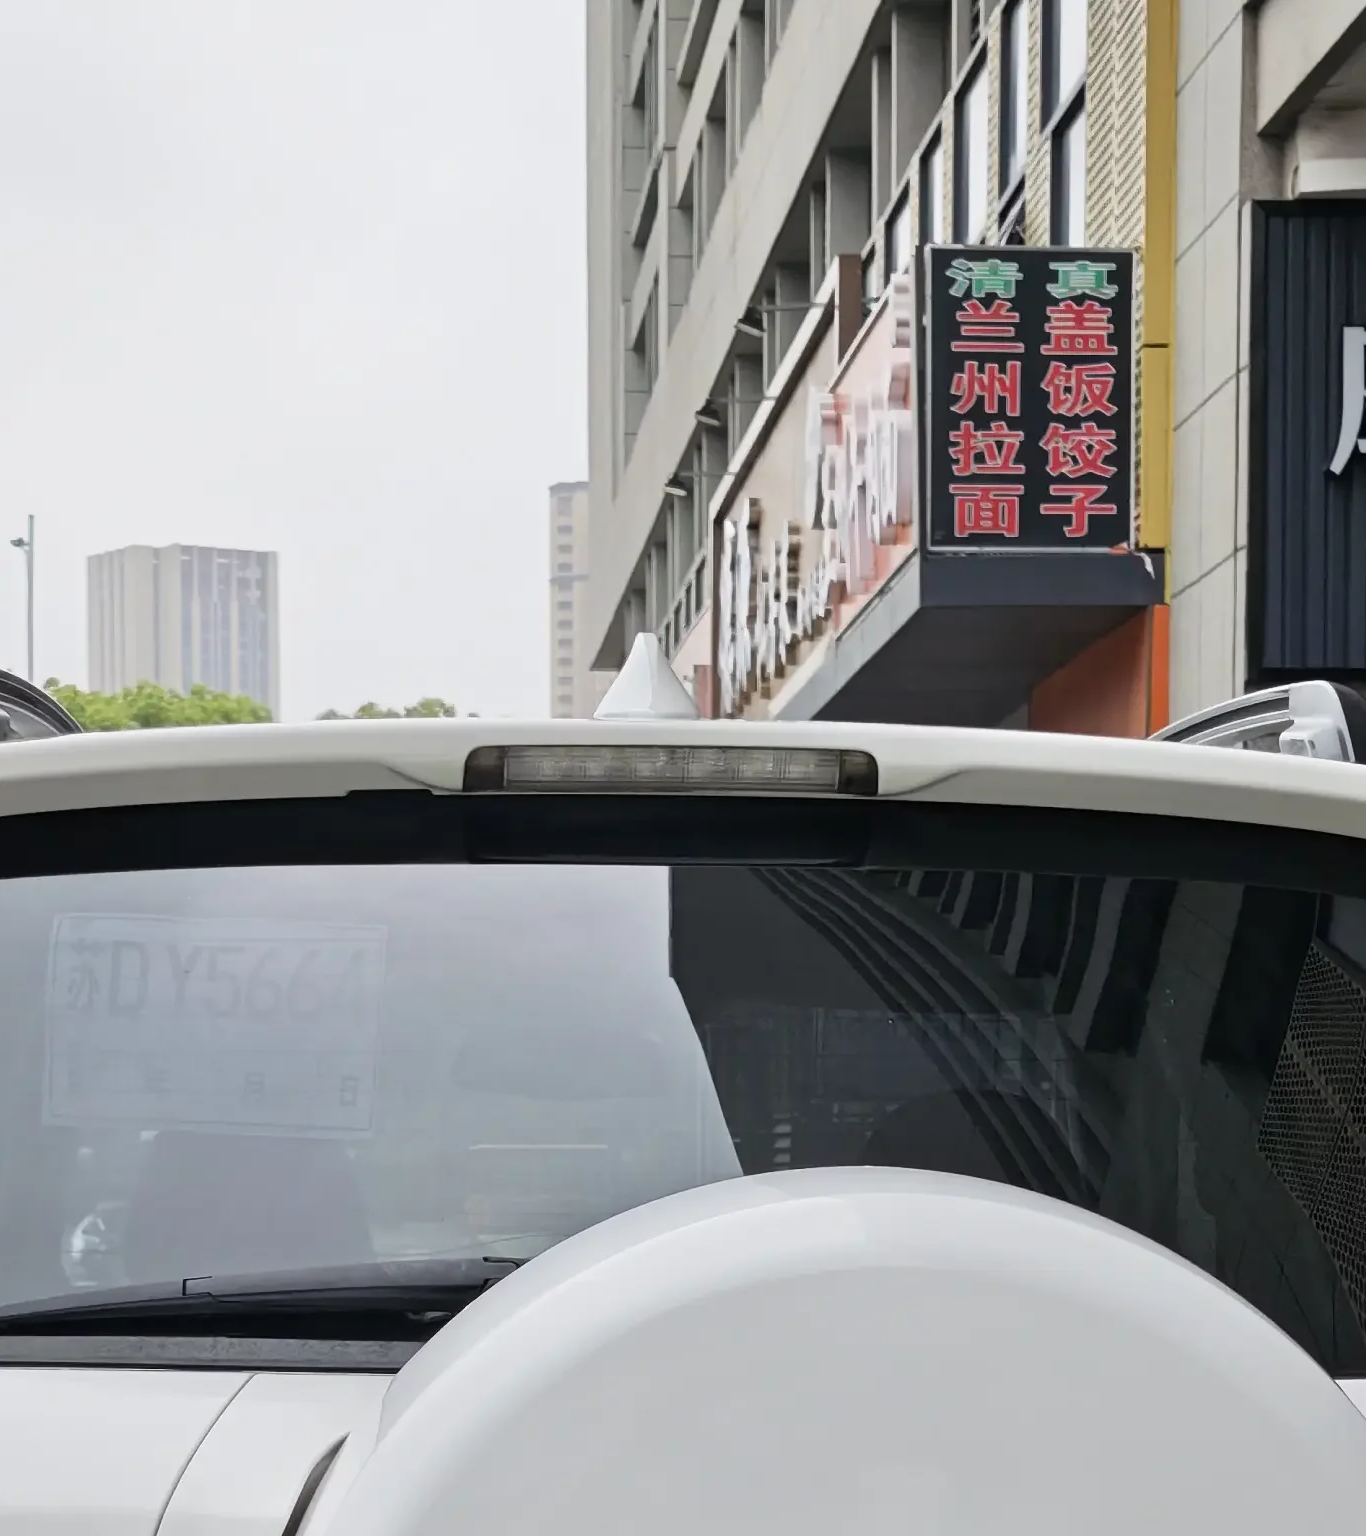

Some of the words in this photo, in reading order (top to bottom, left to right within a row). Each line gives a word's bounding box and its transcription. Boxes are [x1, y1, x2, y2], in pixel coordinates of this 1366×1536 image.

[946, 258, 1119, 299] 清真
[948, 300, 1026, 538] 兰州拉面
[1039, 300, 1119, 538] 盖饭饺子
